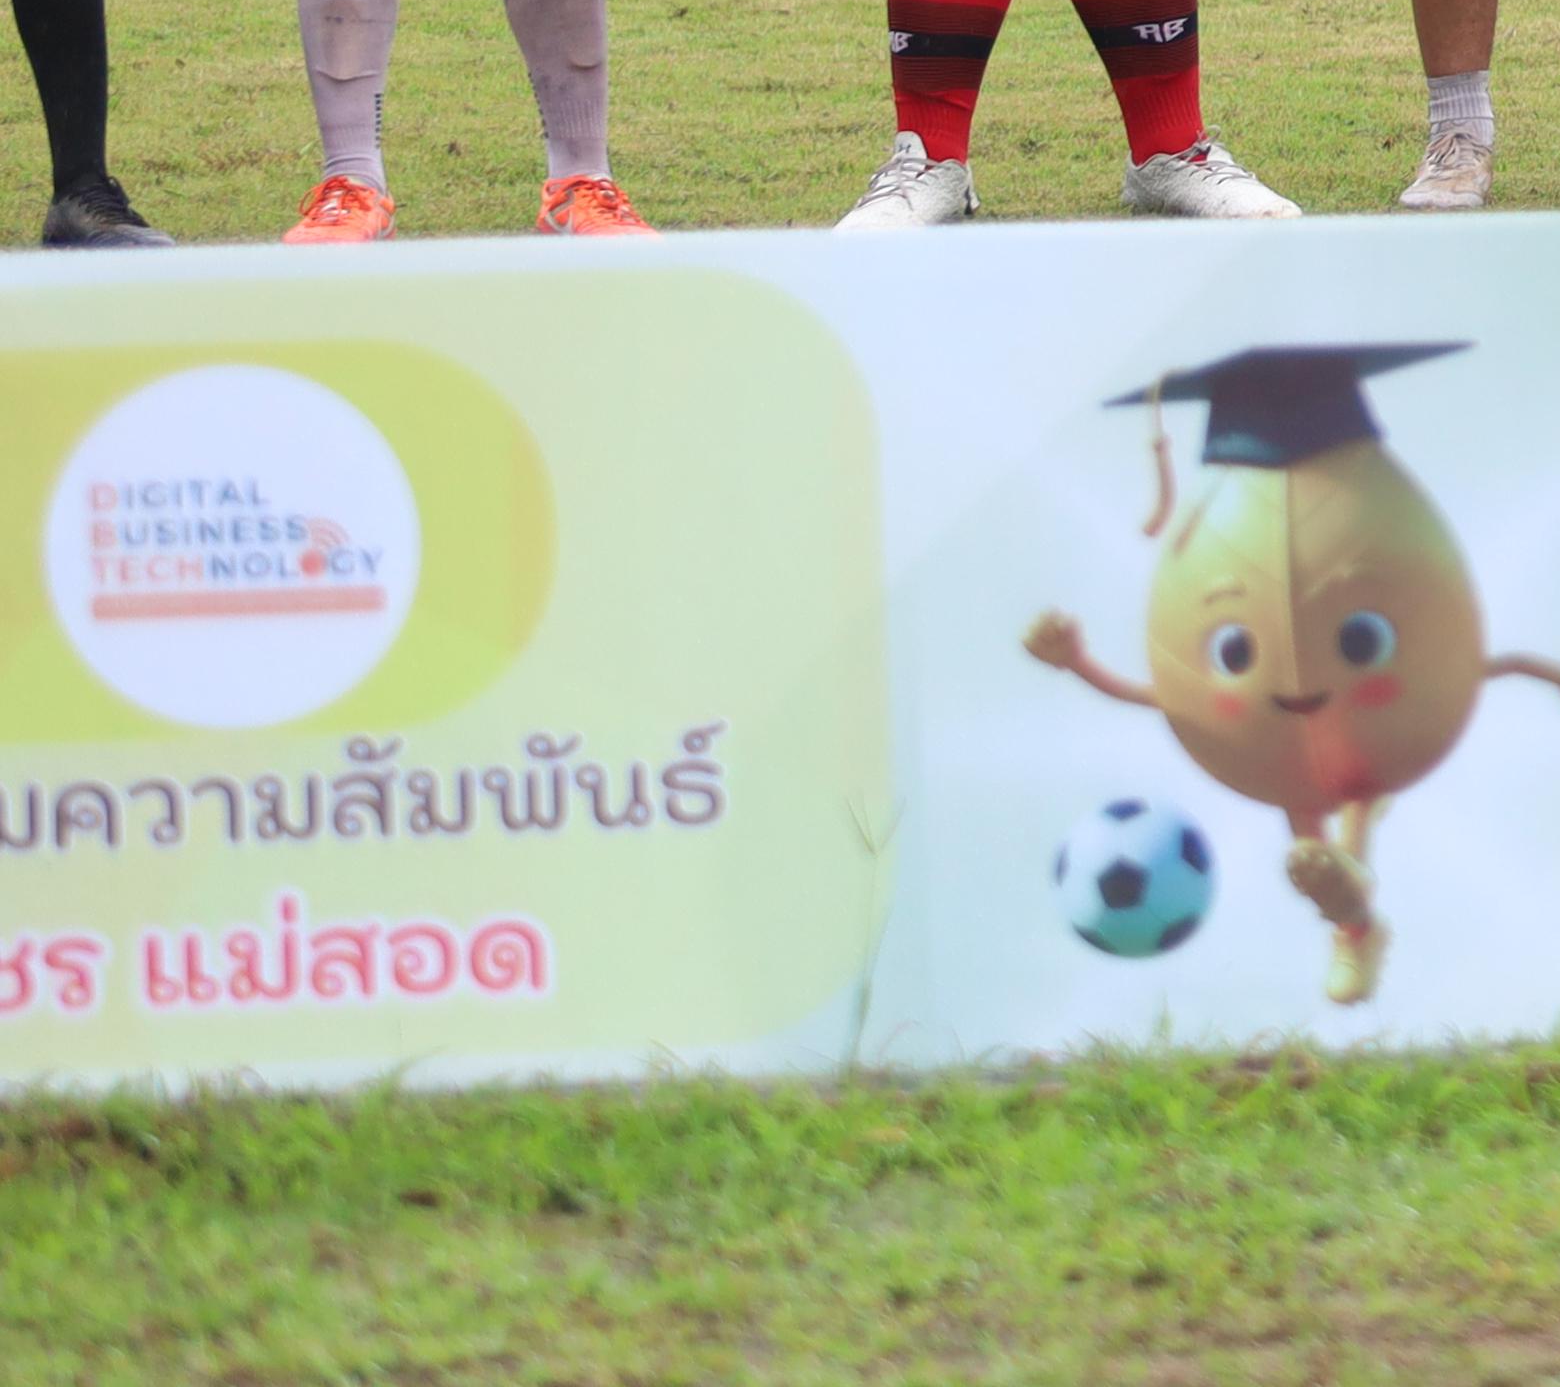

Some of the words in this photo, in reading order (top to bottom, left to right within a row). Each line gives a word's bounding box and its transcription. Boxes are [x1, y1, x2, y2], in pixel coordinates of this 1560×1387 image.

[88, 478, 268, 511] DIGITAL
[88, 515, 309, 549] BUSINESS
[92, 548, 384, 583] TECHNOLOGY
[145, 894, 547, 1007] แม่สอด
